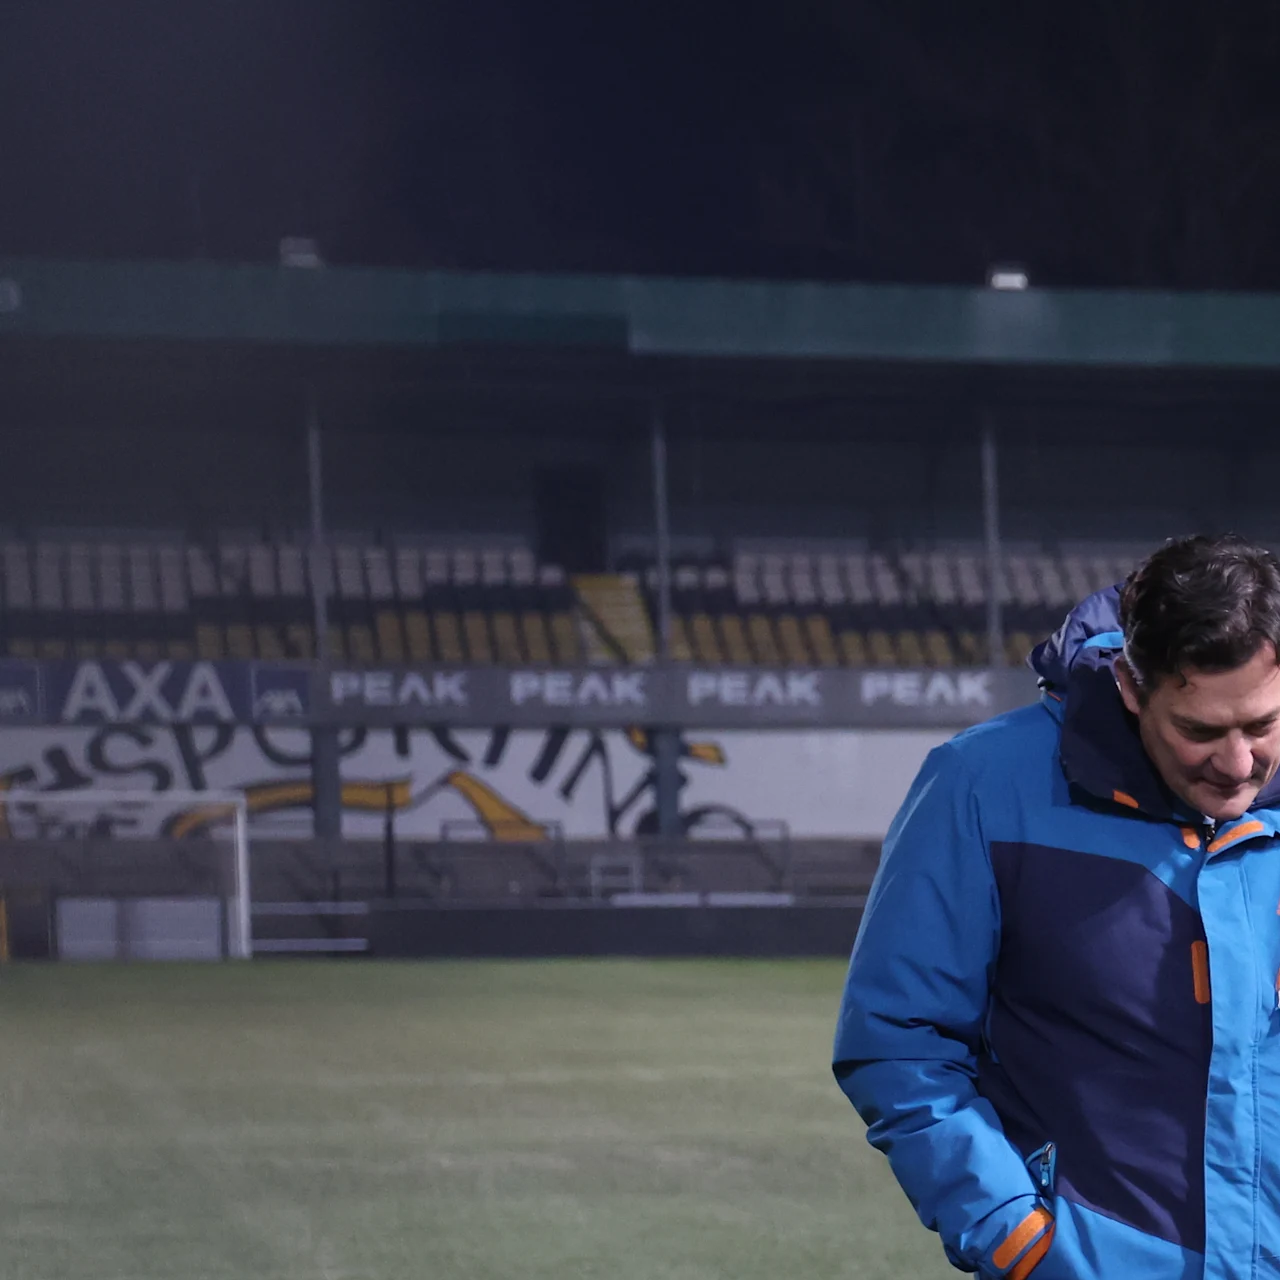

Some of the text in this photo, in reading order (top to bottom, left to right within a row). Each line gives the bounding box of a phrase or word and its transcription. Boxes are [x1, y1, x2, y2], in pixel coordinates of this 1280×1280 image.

[60, 660, 238, 722] AXA
[331, 671, 469, 705] PEAK
[510, 671, 648, 705] PEAK
[687, 671, 822, 705] PEAK
[861, 671, 993, 705] PEAK
